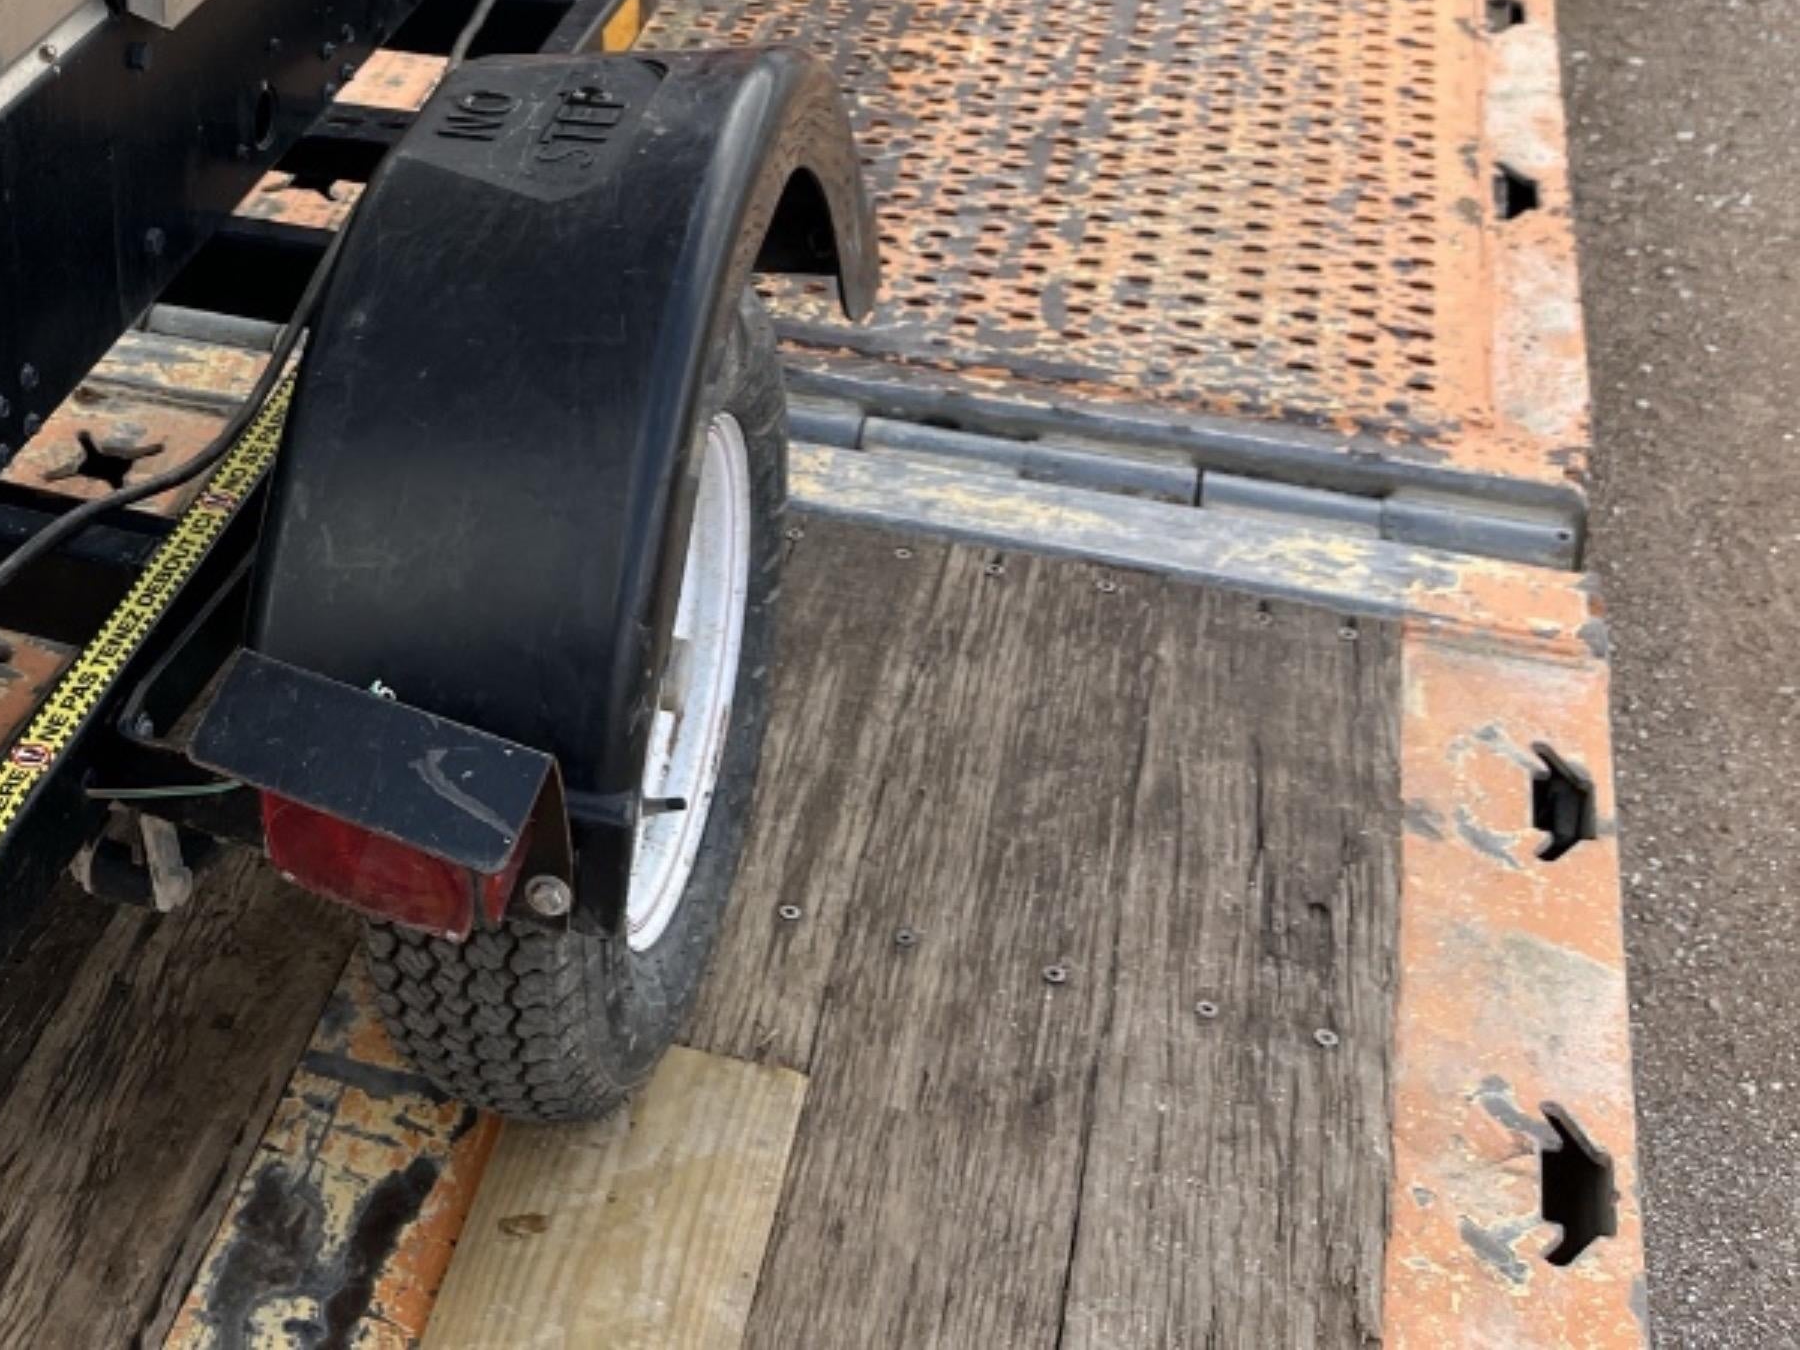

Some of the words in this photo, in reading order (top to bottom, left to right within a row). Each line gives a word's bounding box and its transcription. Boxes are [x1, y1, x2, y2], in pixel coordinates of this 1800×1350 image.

[435, 90, 512, 142] NO
[41, 713, 70, 741] NE
[60, 670, 101, 711] PAS
[91, 609, 145, 666] TENEZ
[136, 537, 196, 607] DEBOUT
